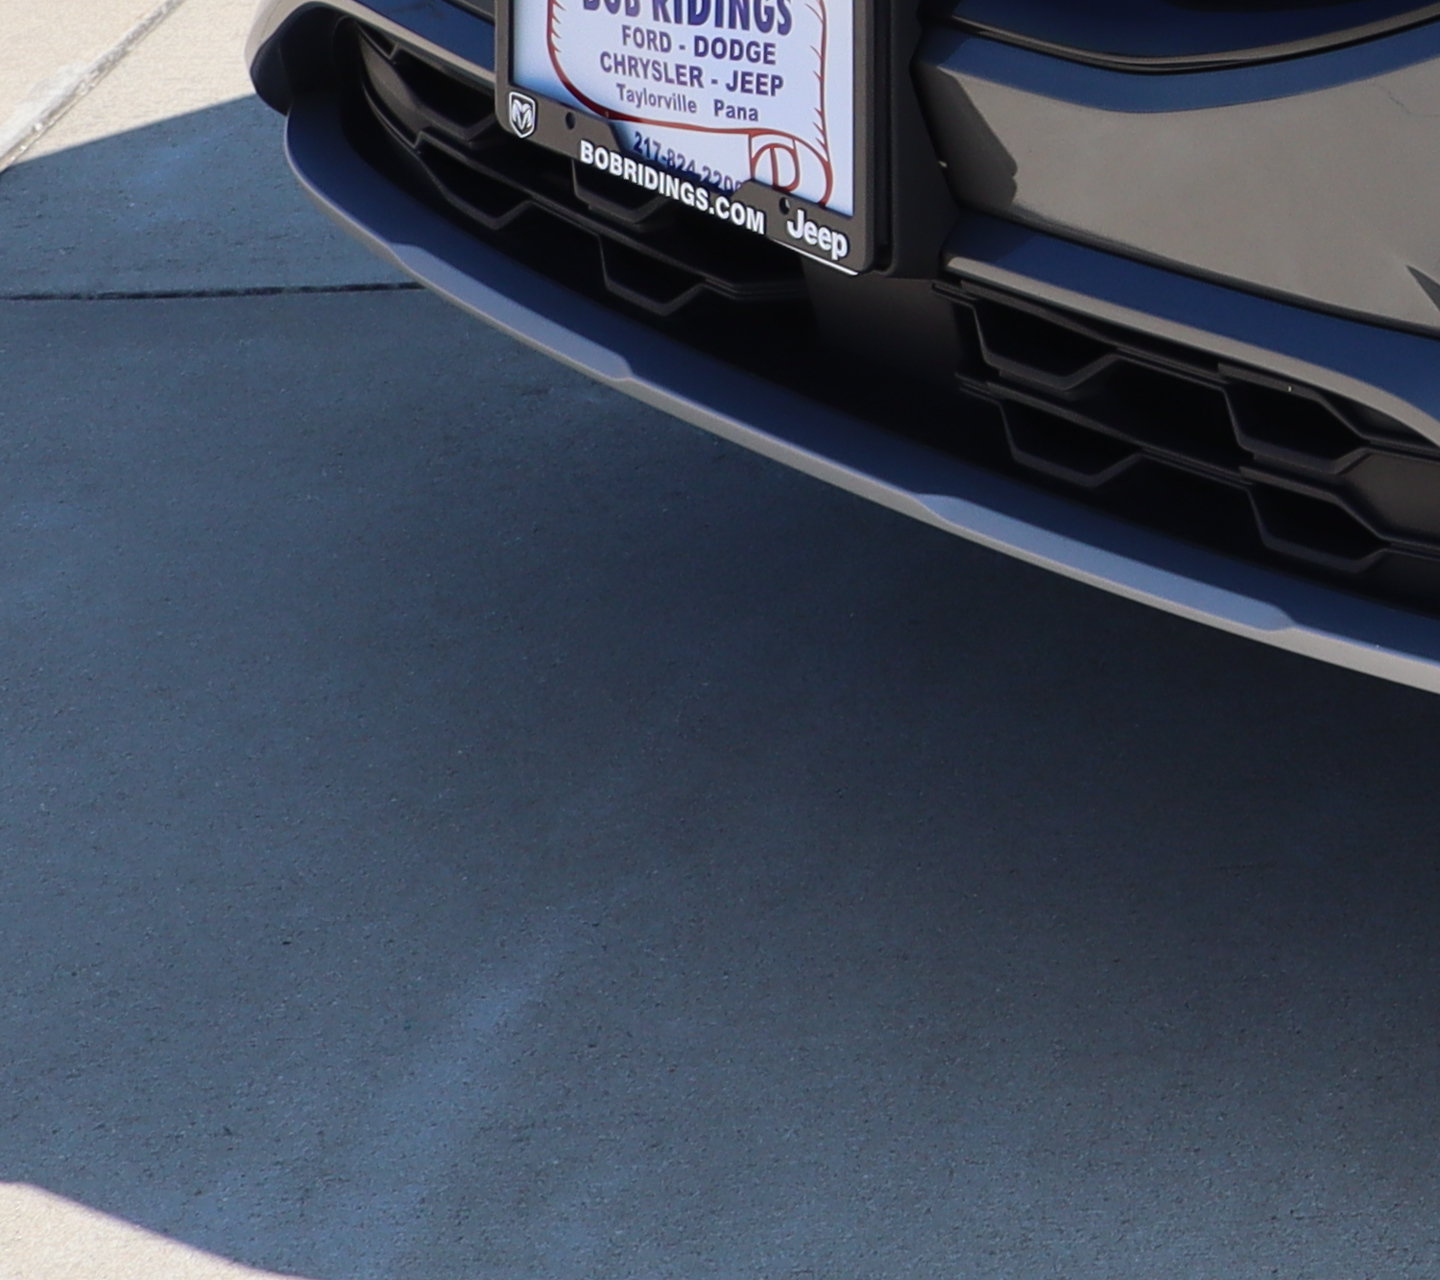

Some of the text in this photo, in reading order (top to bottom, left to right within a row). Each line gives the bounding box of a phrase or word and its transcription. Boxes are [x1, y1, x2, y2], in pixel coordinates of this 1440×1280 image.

[621, 24, 673, 55] FORD
[693, 36, 777, 66] DODGE
[599, 51, 704, 89] CHRYSLER
[725, 71, 785, 98] JEEP
[616, 83, 760, 123] Taylorville Pana
[580, 139, 766, 236] BOBRIDINGS.COM
[786, 209, 849, 261] Jeep
